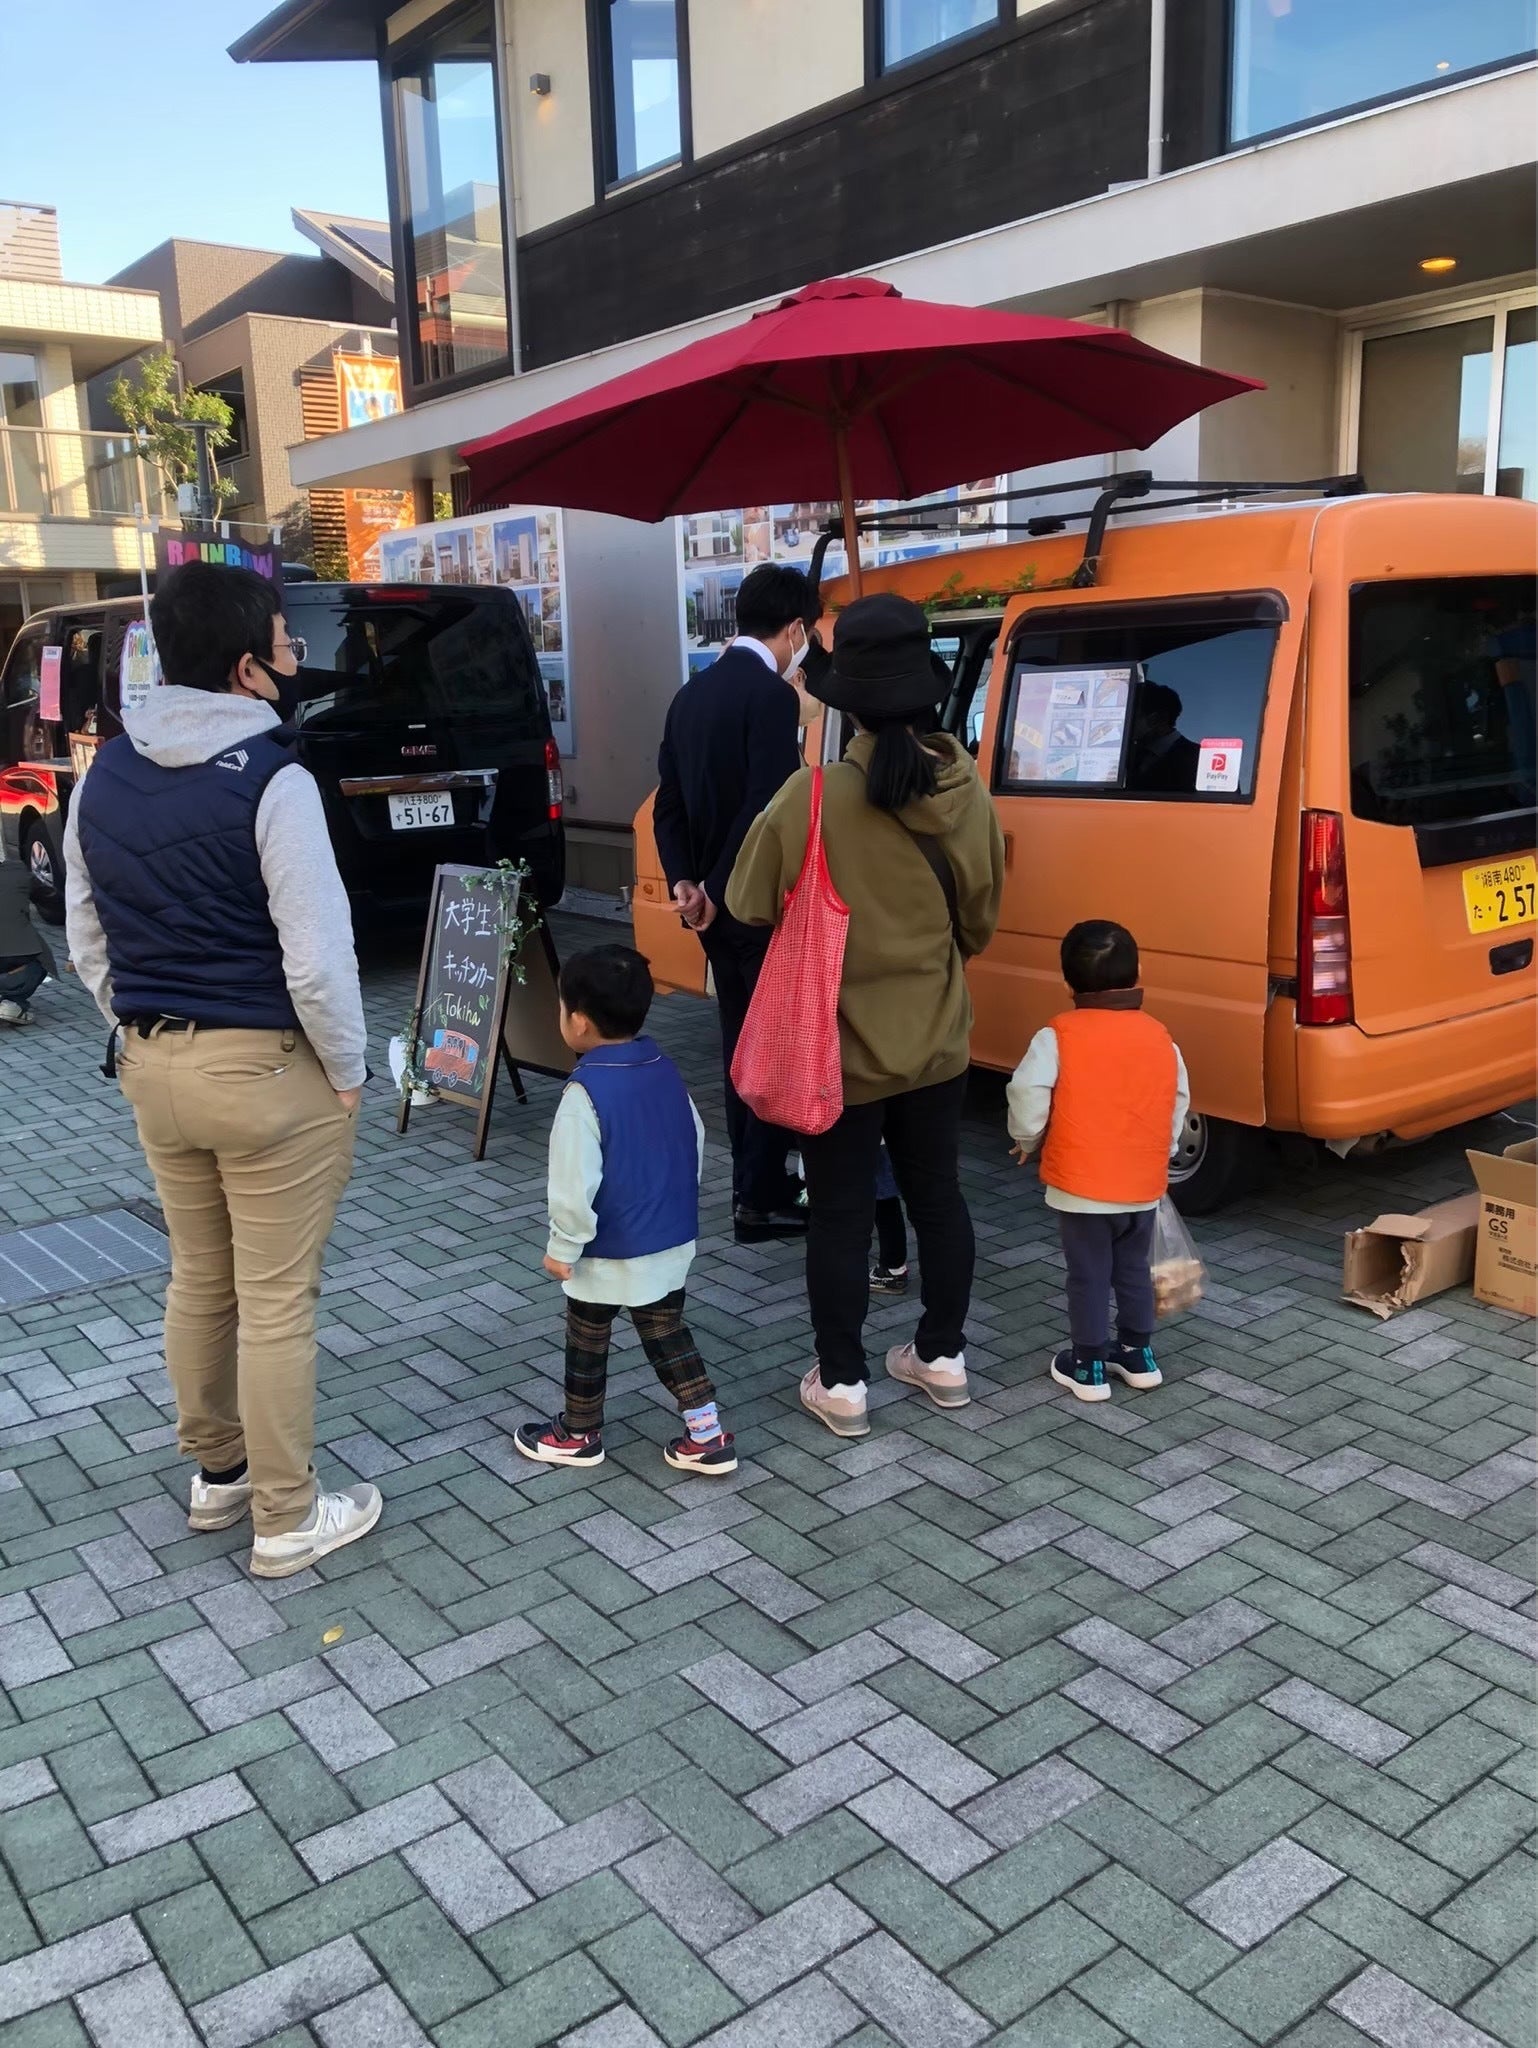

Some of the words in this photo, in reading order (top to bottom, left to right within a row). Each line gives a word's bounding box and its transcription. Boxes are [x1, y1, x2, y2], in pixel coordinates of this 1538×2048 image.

[1206, 772, 1229, 781] PayPay
[404, 805, 450, 826] 51-67
[444, 897, 491, 936] 大学生
[1473, 904, 1483, 919] た
[443, 950, 495, 989] キッチンカー
[1484, 1202, 1516, 1220] 業務用
[1488, 1218, 1509, 1234] GS
